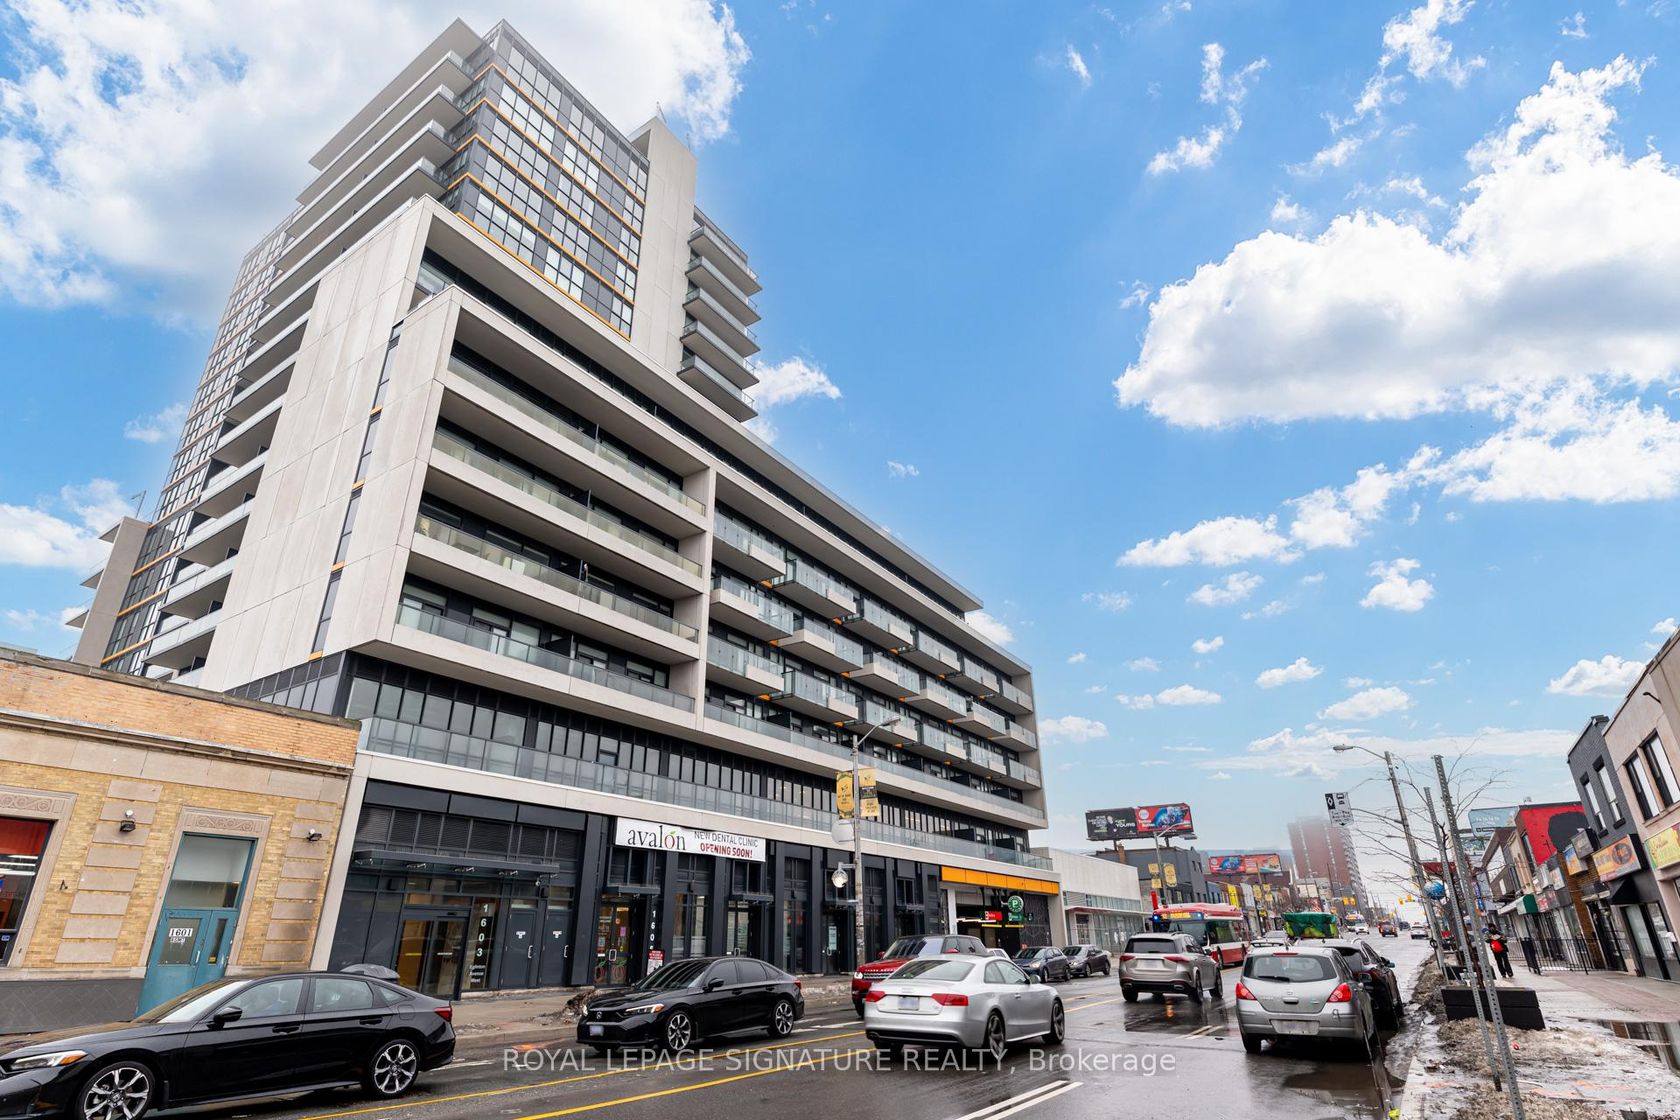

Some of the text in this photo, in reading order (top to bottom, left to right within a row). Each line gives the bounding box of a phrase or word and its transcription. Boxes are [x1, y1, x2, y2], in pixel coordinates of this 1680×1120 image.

[694, 830, 759, 848] NEW DENTAL CLINIC
[700, 842, 753, 859] OPENING SOON!
[171, 928, 191, 937] 1601
